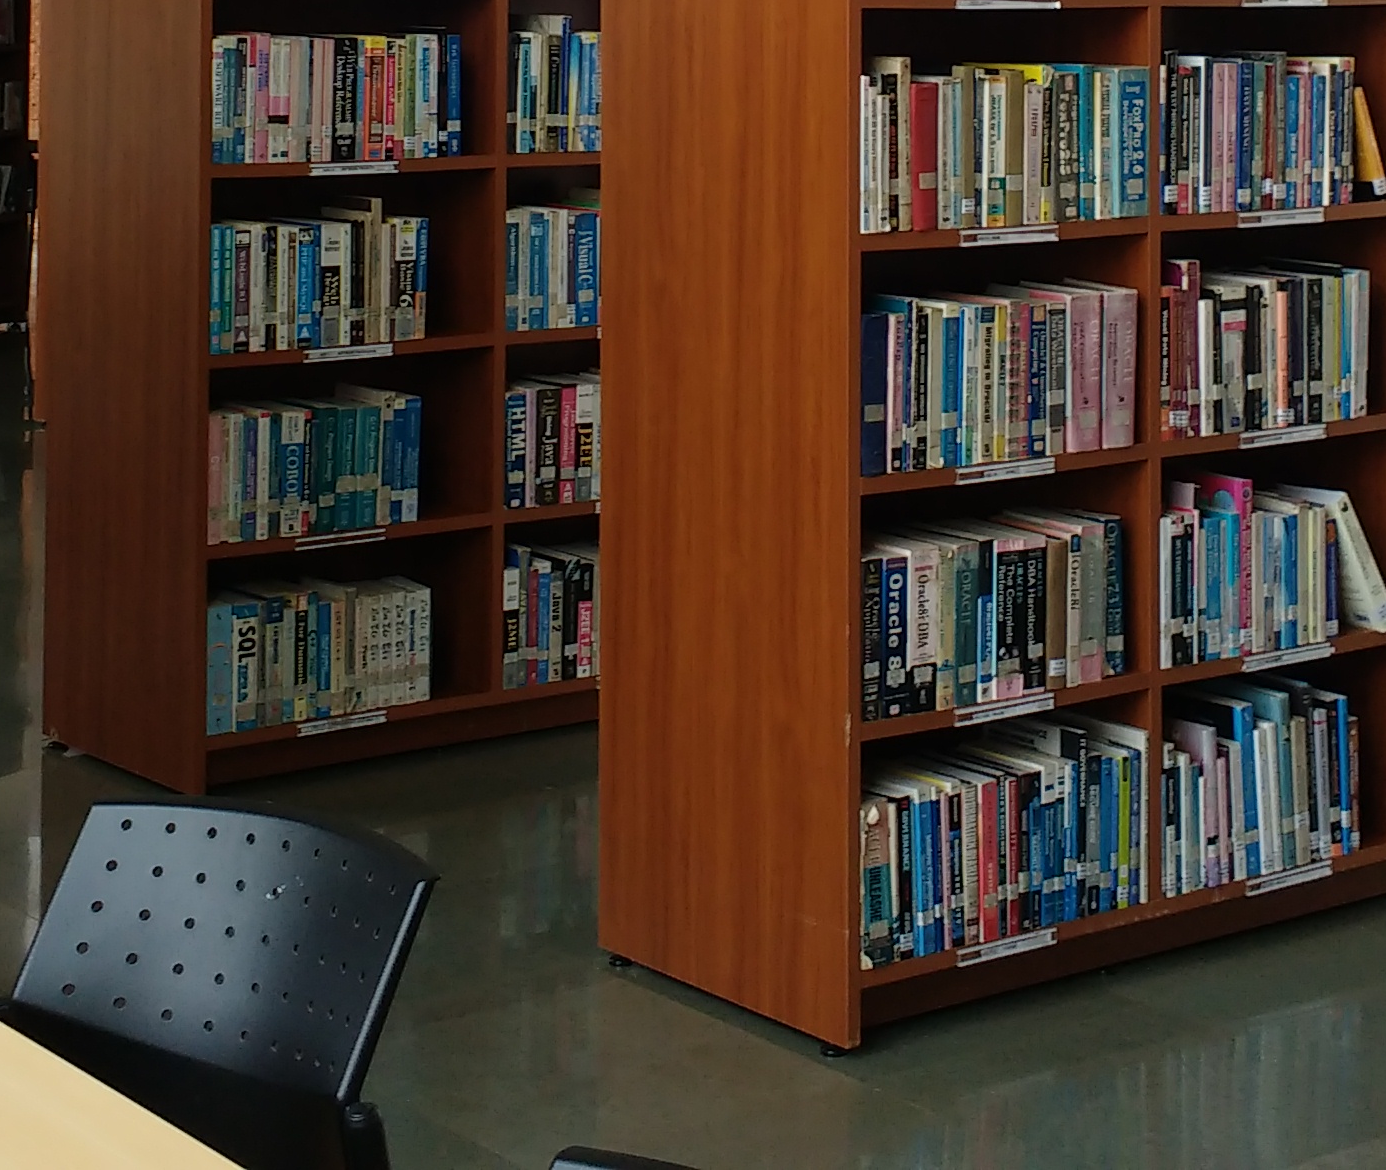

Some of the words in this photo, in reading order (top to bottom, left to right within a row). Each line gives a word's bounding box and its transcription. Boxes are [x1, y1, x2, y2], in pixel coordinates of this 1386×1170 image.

[1132, 99, 1144, 147] FoxPro
[1132, 150, 1144, 175] 2.6
[578, 238, 592, 273] Visual
[984, 326, 992, 370] Migrating
[511, 408, 525, 461] HTML
[543, 436, 558, 465] Java
[577, 425, 593, 465] J2EE
[1005, 564, 1015, 587] The
[1026, 560, 1036, 586] DBA
[888, 573, 904, 648] Oracle
[997, 565, 1006, 622] Reference
[917, 623, 930, 649] DBA
[1004, 590, 1015, 644] Complete
[237, 626, 256, 663] SQL
